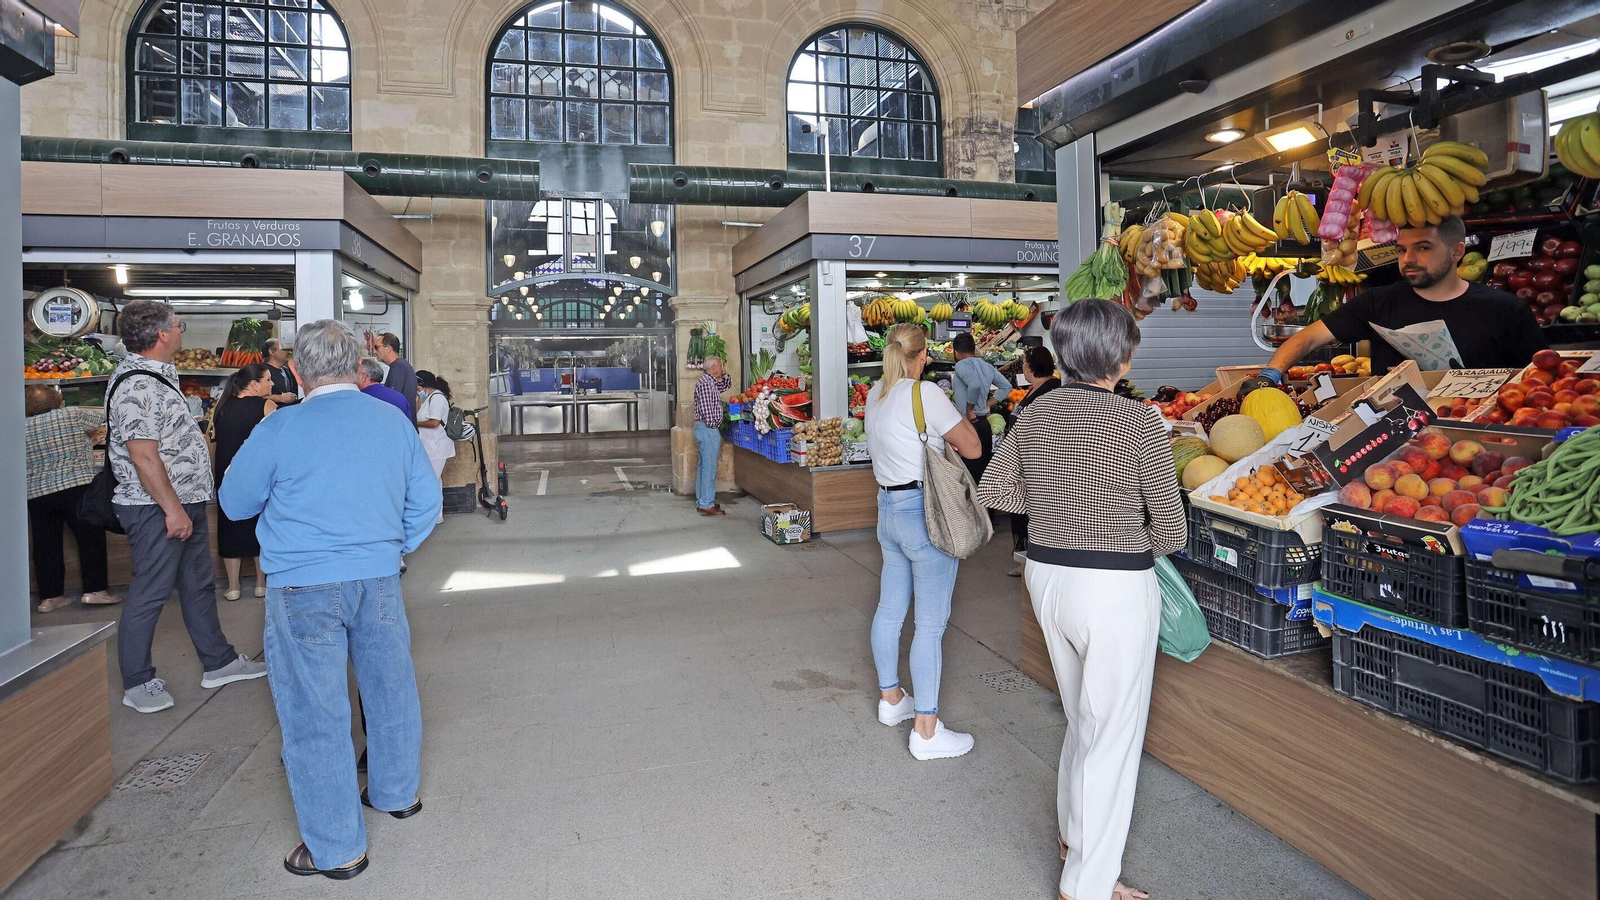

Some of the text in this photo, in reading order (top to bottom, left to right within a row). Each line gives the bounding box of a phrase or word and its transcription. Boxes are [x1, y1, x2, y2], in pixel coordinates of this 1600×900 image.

[207, 219, 301, 232] Frutas y Verduras
[188, 232, 301, 247] E. GRANADOS
[351, 230, 362, 258] 38
[848, 235, 877, 258] 37
[1024, 241, 1059, 251] Frutas y Ve
[1390, 615, 1463, 640] Las Virtudes
